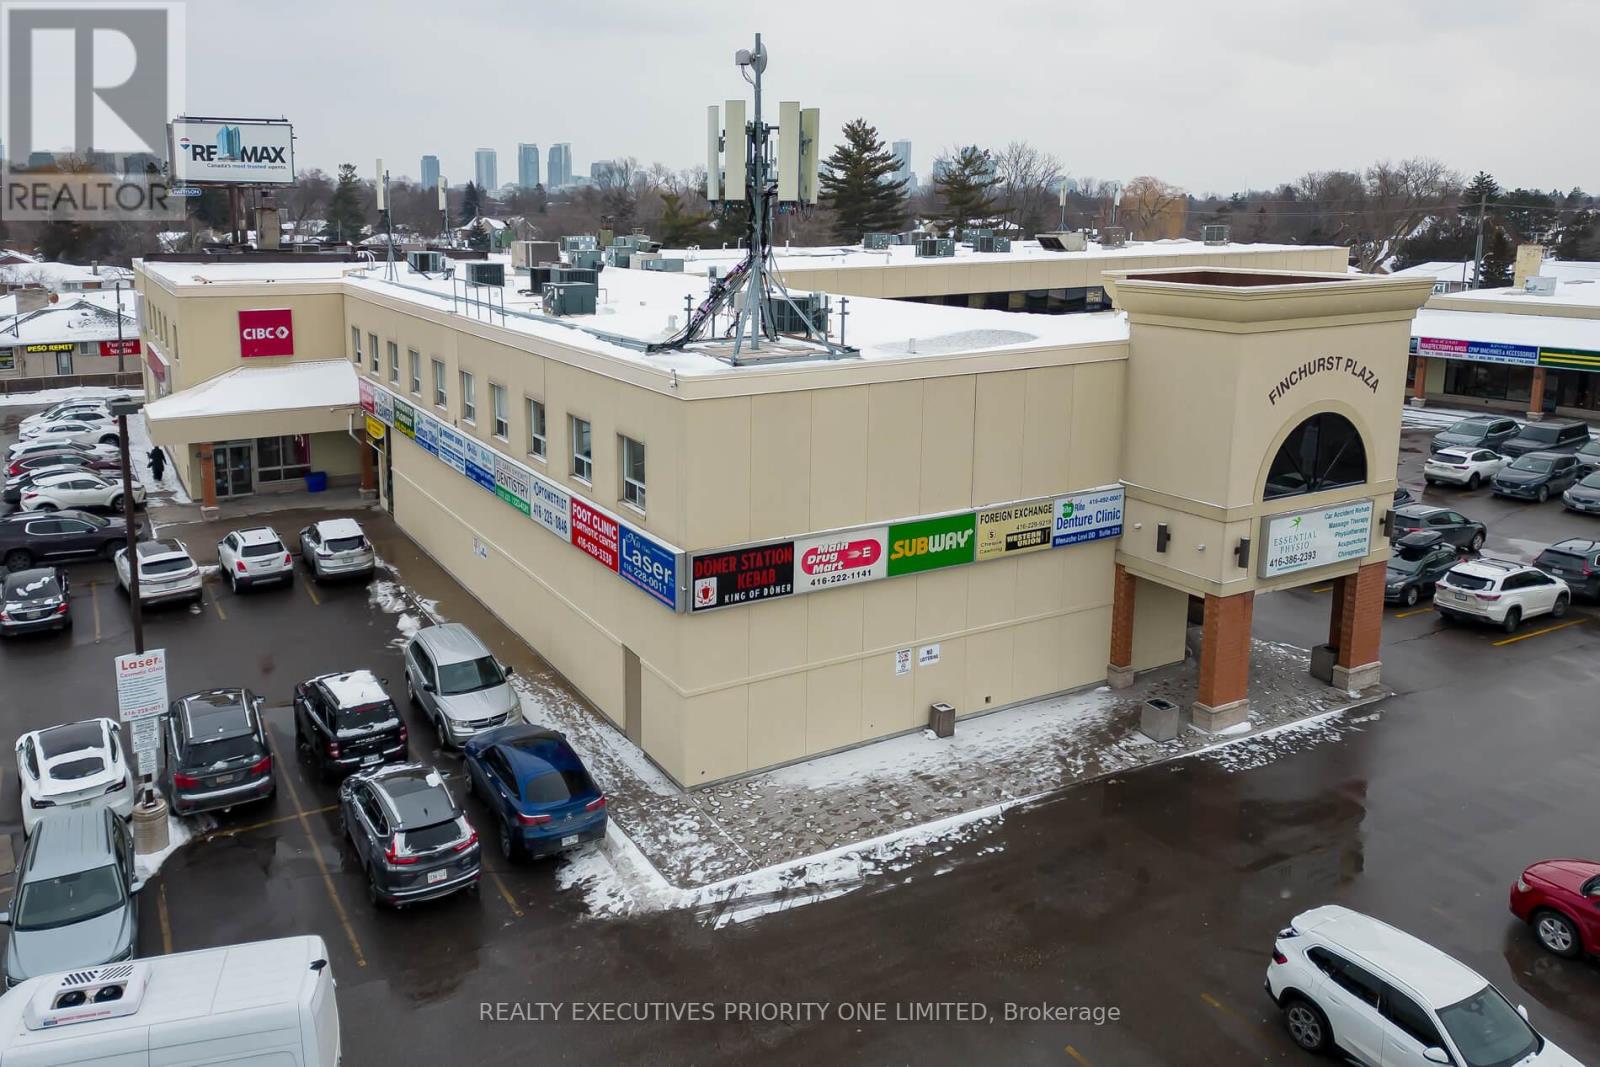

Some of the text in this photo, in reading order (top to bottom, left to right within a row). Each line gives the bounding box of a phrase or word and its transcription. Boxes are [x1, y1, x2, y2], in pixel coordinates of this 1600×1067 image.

[242, 327, 275, 340] CIBC
[27, 343, 74, 353] PESO REMIT
[1268, 356, 1380, 406] FINCHURST PLAZA
[496, 469, 529, 500] DENTISTRY
[572, 502, 617, 540] FOOT CLINIC
[980, 503, 1053, 525] FOREIGN EXCHANGE
[1056, 507, 1121, 530] Denture Clinic
[1324, 506, 1370, 520] Car Accident Rehab
[1328, 516, 1369, 530] Massage Therapy
[576, 520, 599, 541] ORTHOTIC
[599, 534, 617, 553] CENTRE
[1006, 530, 1041, 543] WESTERN
[1273, 530, 1317, 546] ESSENTIAL
[1334, 527, 1368, 538] Physiotherapy
[817, 541, 849, 554] Main
[890, 528, 974, 560] SUBWAY
[1017, 538, 1041, 547] UNION
[1280, 541, 1310, 554] PHYSIO
[1337, 537, 1367, 548] Acupuncture
[622, 538, 673, 584] Laser
[741, 545, 793, 571] STATION
[807, 551, 839, 565] Drug
[1269, 550, 1317, 568] 416-386-2393
[812, 560, 844, 575] Mart
[736, 568, 776, 590] KEBAB
[810, 568, 872, 587] 416-222-1141
[724, 591, 746, 604] KING
[749, 588, 760, 599] OF
[121, 656, 159, 671] Laser
